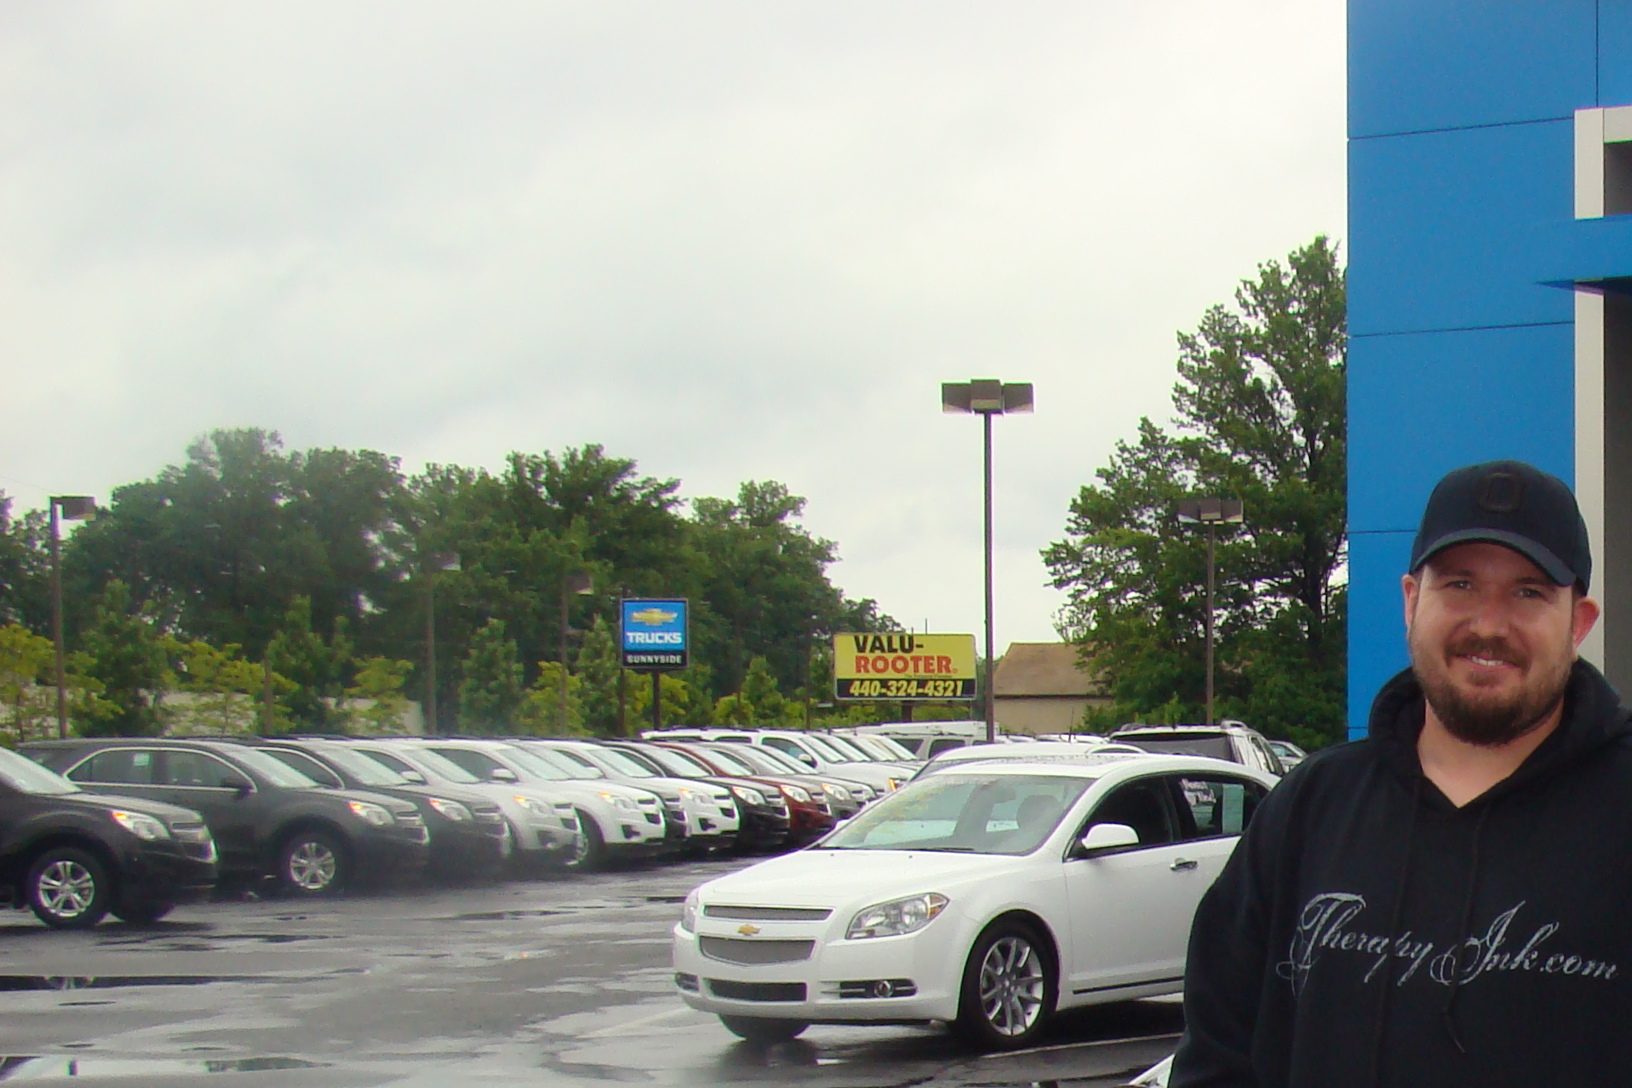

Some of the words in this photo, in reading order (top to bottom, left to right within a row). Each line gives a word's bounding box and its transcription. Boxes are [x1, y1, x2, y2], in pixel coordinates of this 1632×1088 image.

[626, 632, 682, 644] TRUCKS
[853, 635, 924, 653] VALU-
[627, 655, 682, 664] SUNNYSIDE
[849, 680, 964, 697] 440-324-4321
[1276, 891, 1434, 997] Therapy
